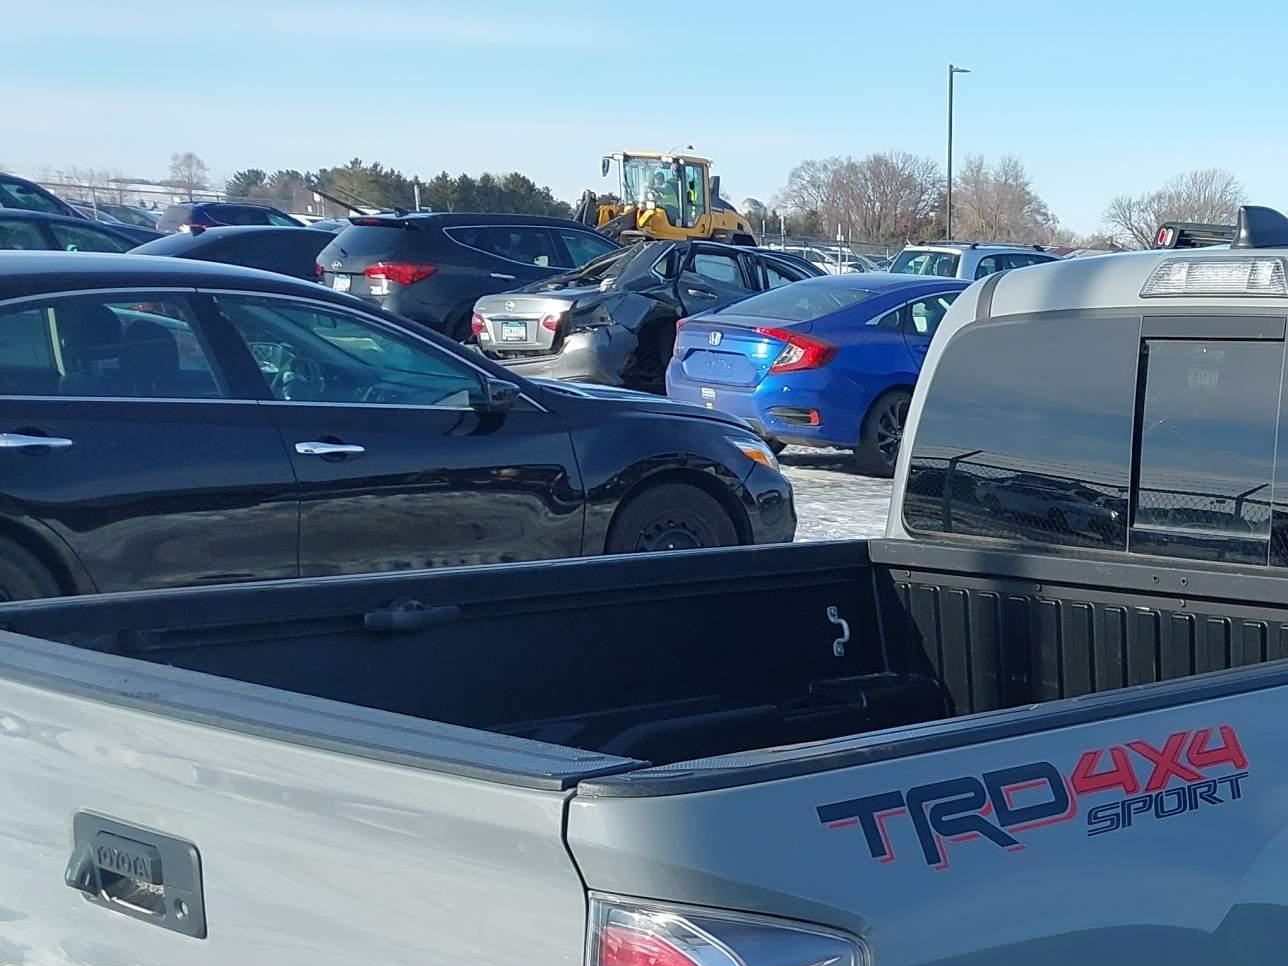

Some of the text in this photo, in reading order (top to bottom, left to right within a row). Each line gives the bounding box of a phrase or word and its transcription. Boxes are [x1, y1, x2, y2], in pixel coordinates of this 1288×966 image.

[815, 761, 1077, 870] TRD
[1087, 771, 1250, 837] SPORT
[96, 845, 153, 880] TOYOTA
